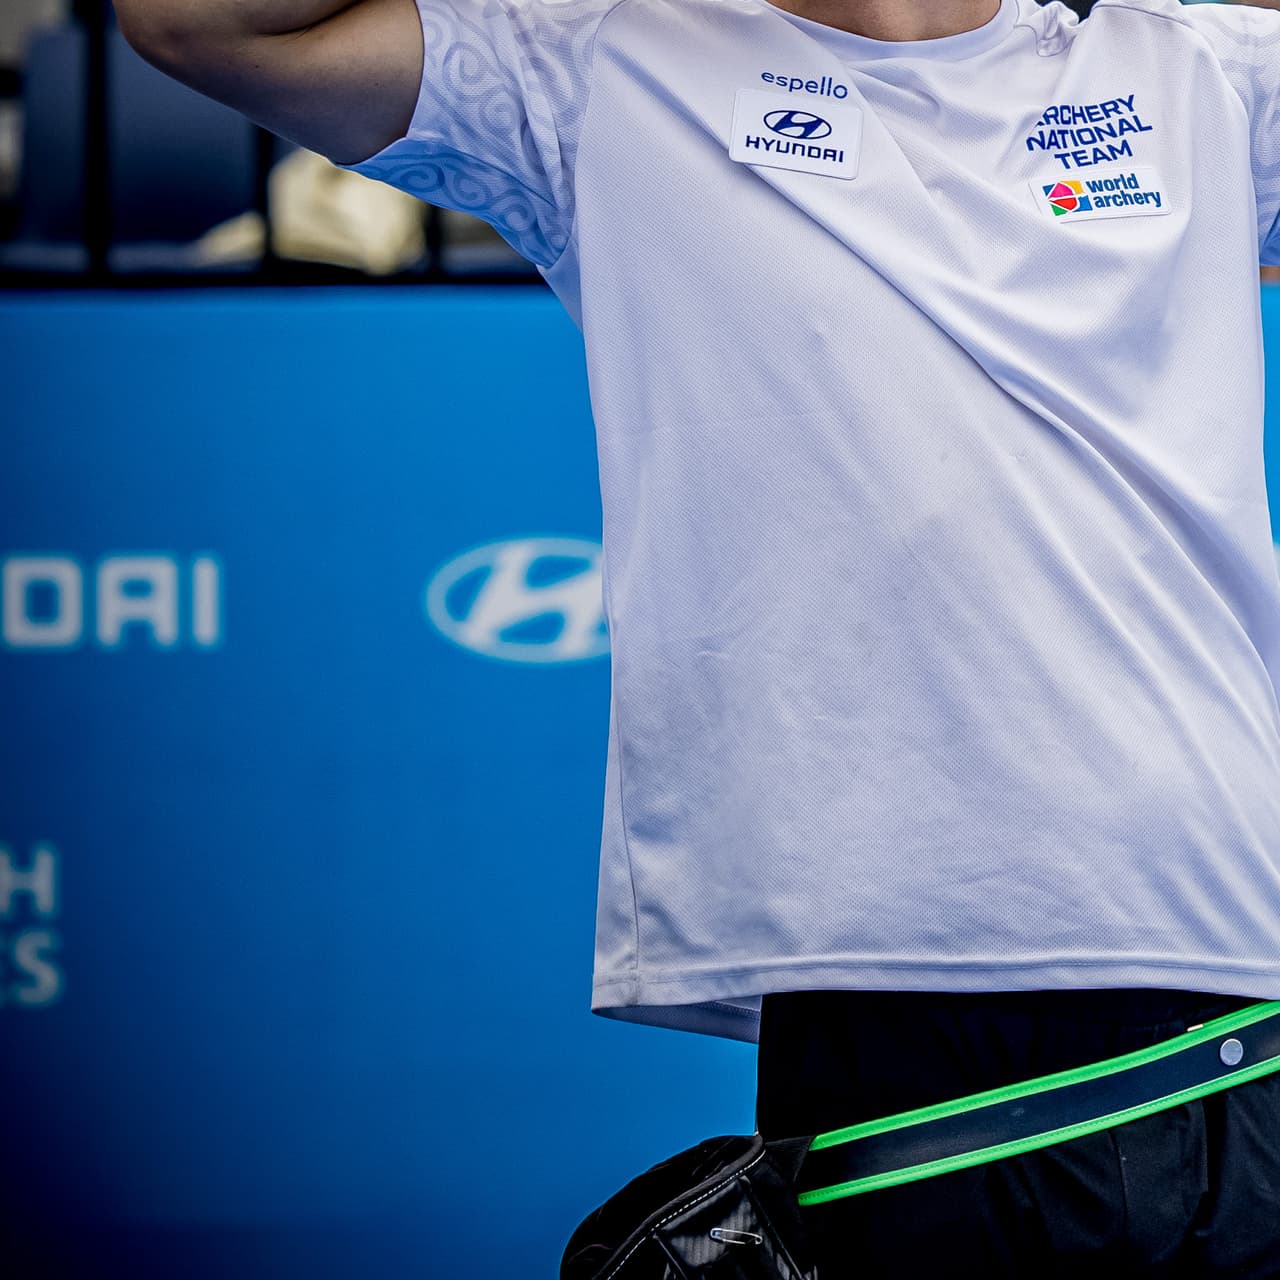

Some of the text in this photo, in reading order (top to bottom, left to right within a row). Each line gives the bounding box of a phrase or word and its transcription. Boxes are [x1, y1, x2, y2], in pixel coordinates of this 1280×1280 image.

[760, 72, 848, 99] espello
[1026, 115, 1153, 151] NATIONAL
[745, 135, 844, 163] HYUNDAI
[1054, 139, 1133, 169] TEAM
[1085, 173, 1140, 193] world
[1093, 190, 1162, 208] archery
[2, 556, 220, 646] DAI
